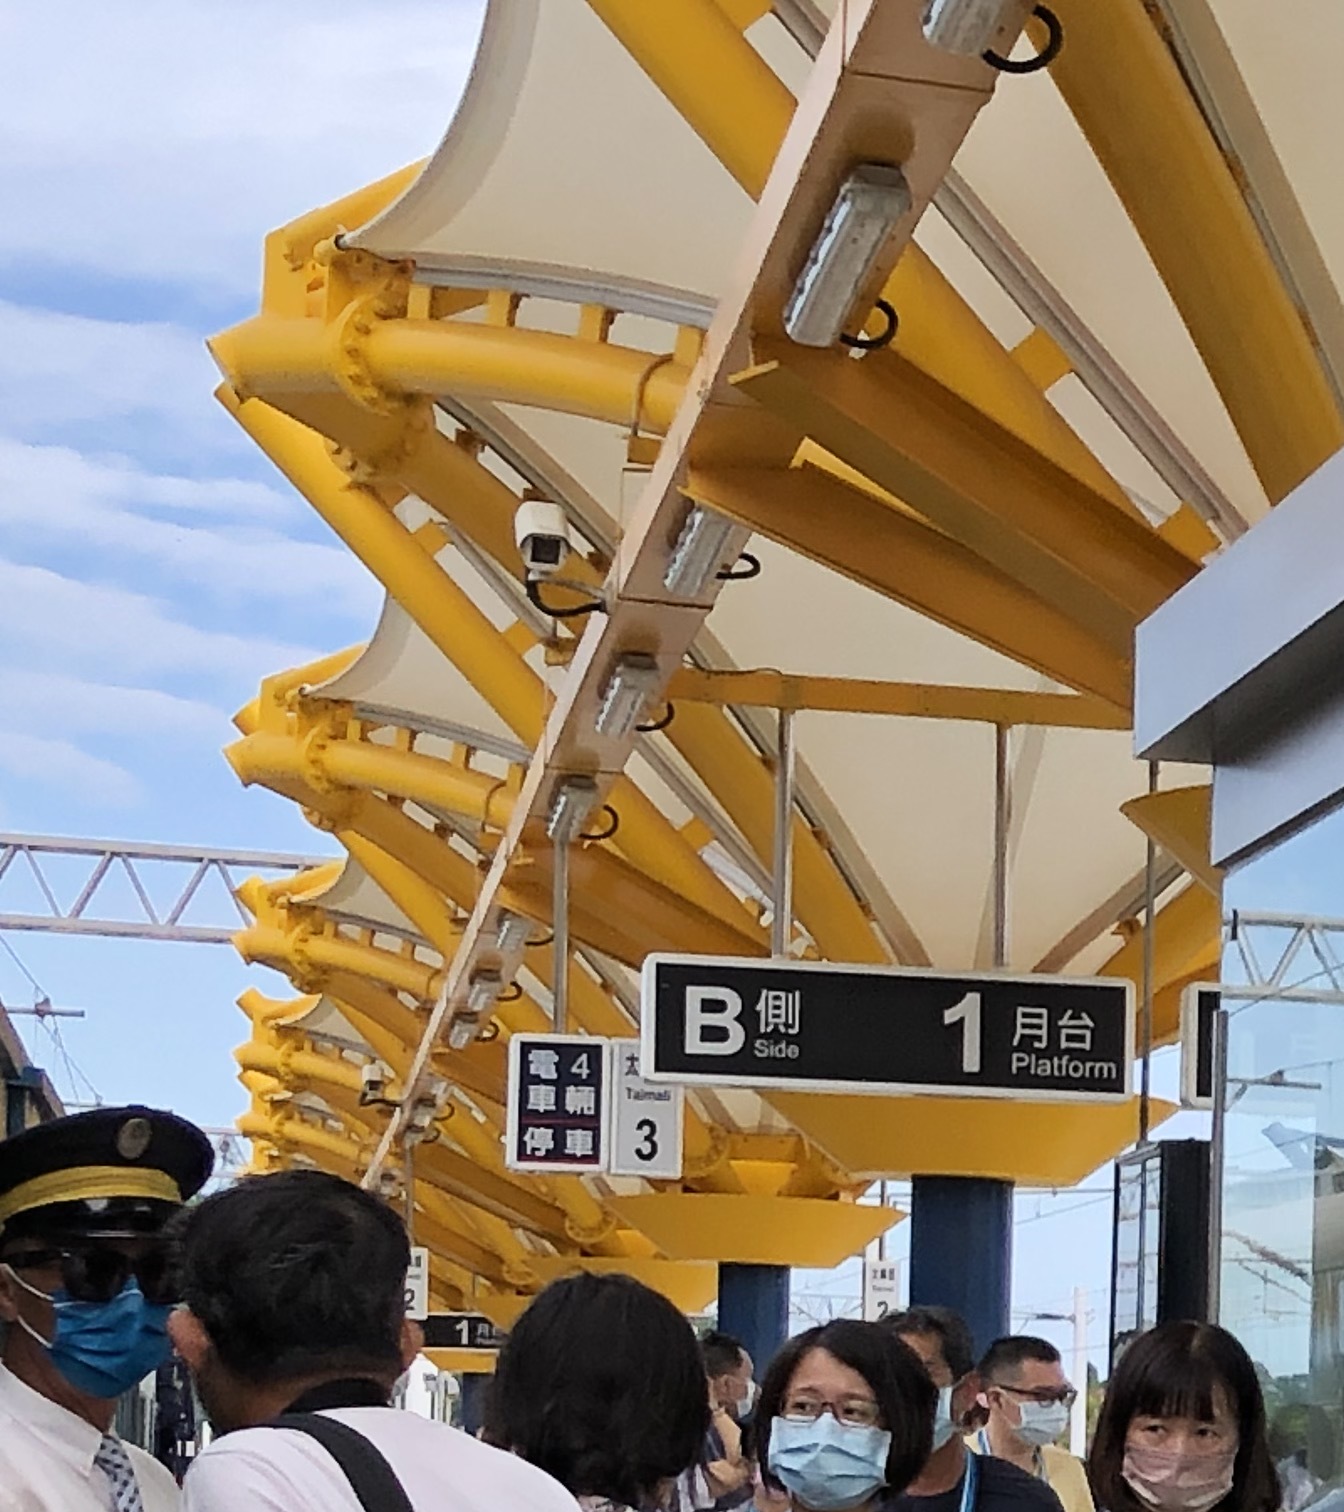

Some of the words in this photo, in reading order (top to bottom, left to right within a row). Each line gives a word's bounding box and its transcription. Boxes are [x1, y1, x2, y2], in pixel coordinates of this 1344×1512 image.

[684, 985, 746, 1056] B
[755, 988, 801, 1035] 側
[943, 991, 981, 1073] 1
[1012, 1006, 1095, 1051] 月台
[753, 1038, 800, 1059] Side
[1011, 1052, 1117, 1079] Platform
[634, 1118, 659, 1162] 3
[455, 1319, 469, 1345] 1
